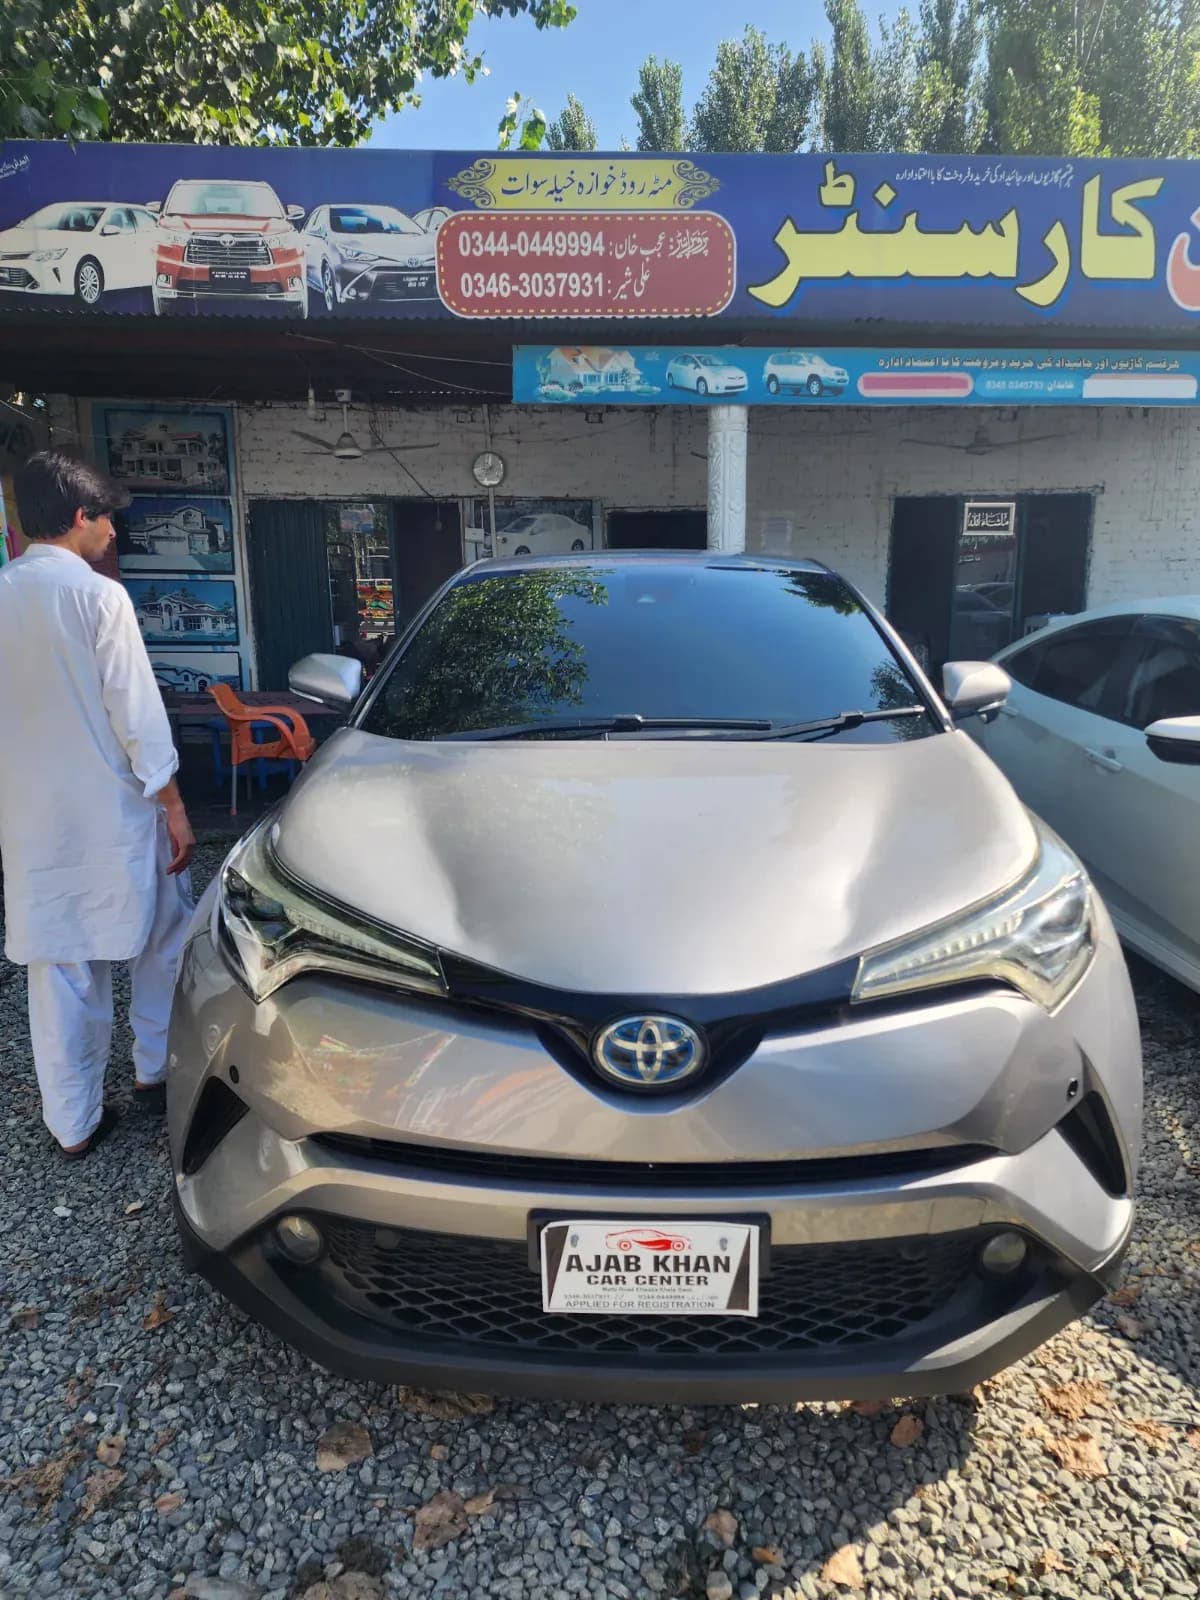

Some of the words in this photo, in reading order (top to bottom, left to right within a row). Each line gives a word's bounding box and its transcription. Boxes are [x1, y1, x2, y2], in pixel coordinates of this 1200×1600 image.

[501, 171, 548, 196] سوات
[546, 169, 575, 202] خیلہ
[577, 165, 617, 198] خوازہ
[619, 168, 646, 195] روڈ
[458, 231, 605, 257] 0344-0449994
[639, 231, 666, 262] عجب
[747, 158, 1020, 308] سنٹر
[1015, 174, 1166, 308] کار
[460, 271, 605, 298] 0346-3037931
[633, 261, 651, 298] علی
[565, 1254, 641, 1273] AJAB
[653, 1255, 731, 1274] KHAN
[586, 1275, 627, 1286] CAR
[635, 1275, 709, 1286] CENTER
[565, 1300, 610, 1309] APPLIED
[613, 1300, 634, 1309] FOR
[638, 1301, 715, 1309] REGISTRATION
